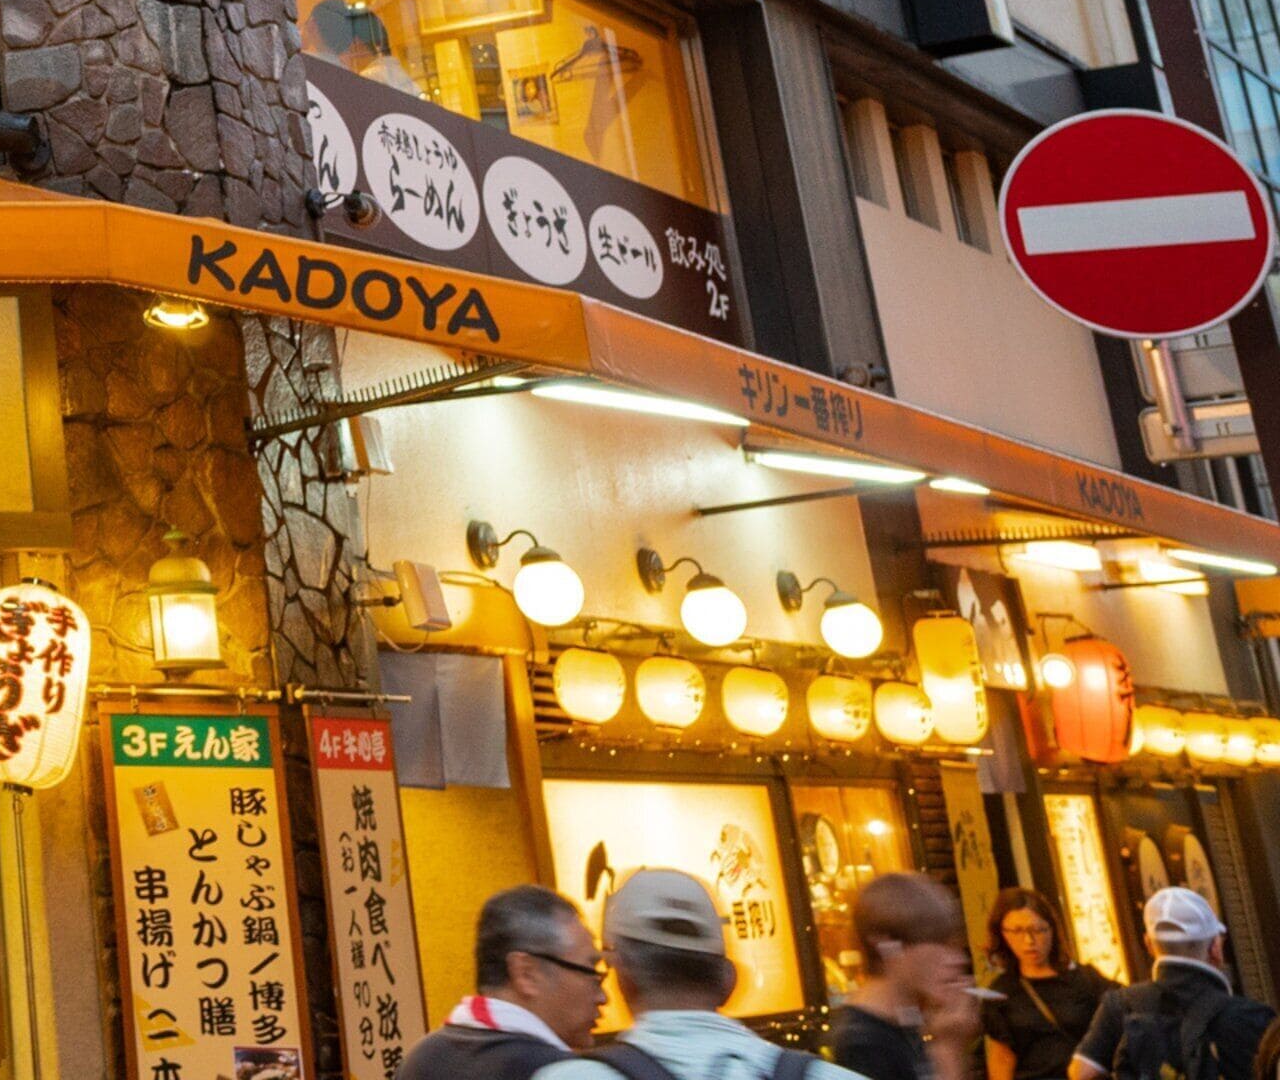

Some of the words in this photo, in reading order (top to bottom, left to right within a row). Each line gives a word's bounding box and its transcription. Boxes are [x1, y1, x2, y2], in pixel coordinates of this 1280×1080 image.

[389, 154, 465, 233] らーめん
[502, 188, 570, 255] ぎょうざ
[598, 223, 657, 272] 生ビール
[665, 226, 727, 281] 飲み処
[187, 233, 500, 342] KADOYA
[706, 280, 730, 320] 2F
[1075, 471, 1145, 521] KADOYA
[38, 605, 79, 714] 手作り
[122, 724, 167, 758] 3F
[173, 724, 261, 762] えん家
[320, 728, 342, 759] 4F
[187, 827, 237, 1037] とんかつ膳
